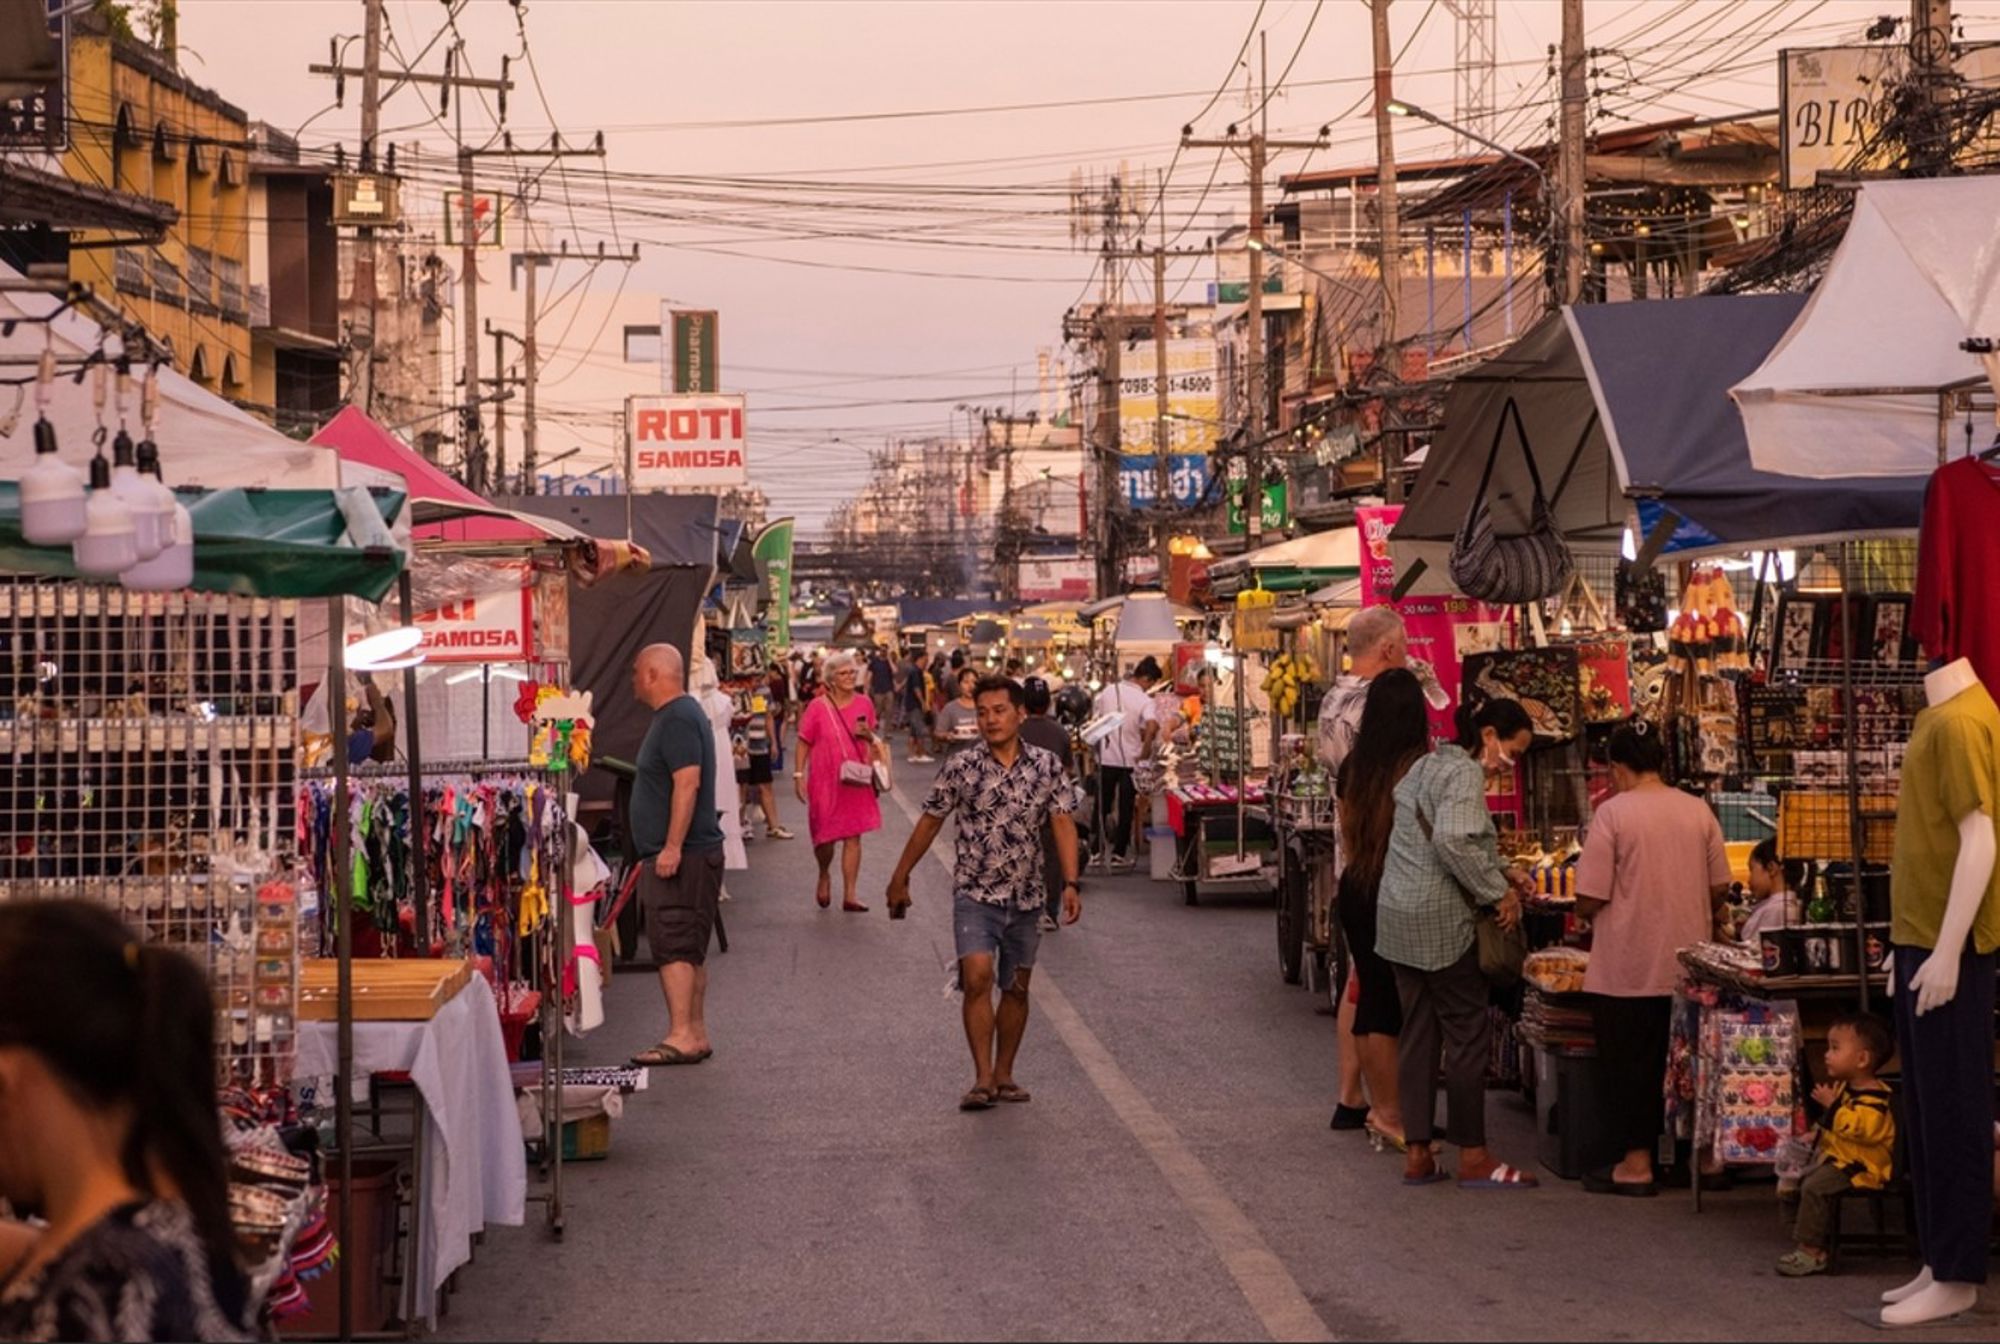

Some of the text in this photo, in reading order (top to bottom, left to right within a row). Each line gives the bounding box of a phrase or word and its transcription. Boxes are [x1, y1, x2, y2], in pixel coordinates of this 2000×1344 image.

[688, 315, 703, 393] Pharmac
[638, 408, 742, 441] ROTI
[638, 450, 742, 469] SAMOSA
[418, 630, 518, 649] SAMOSA
